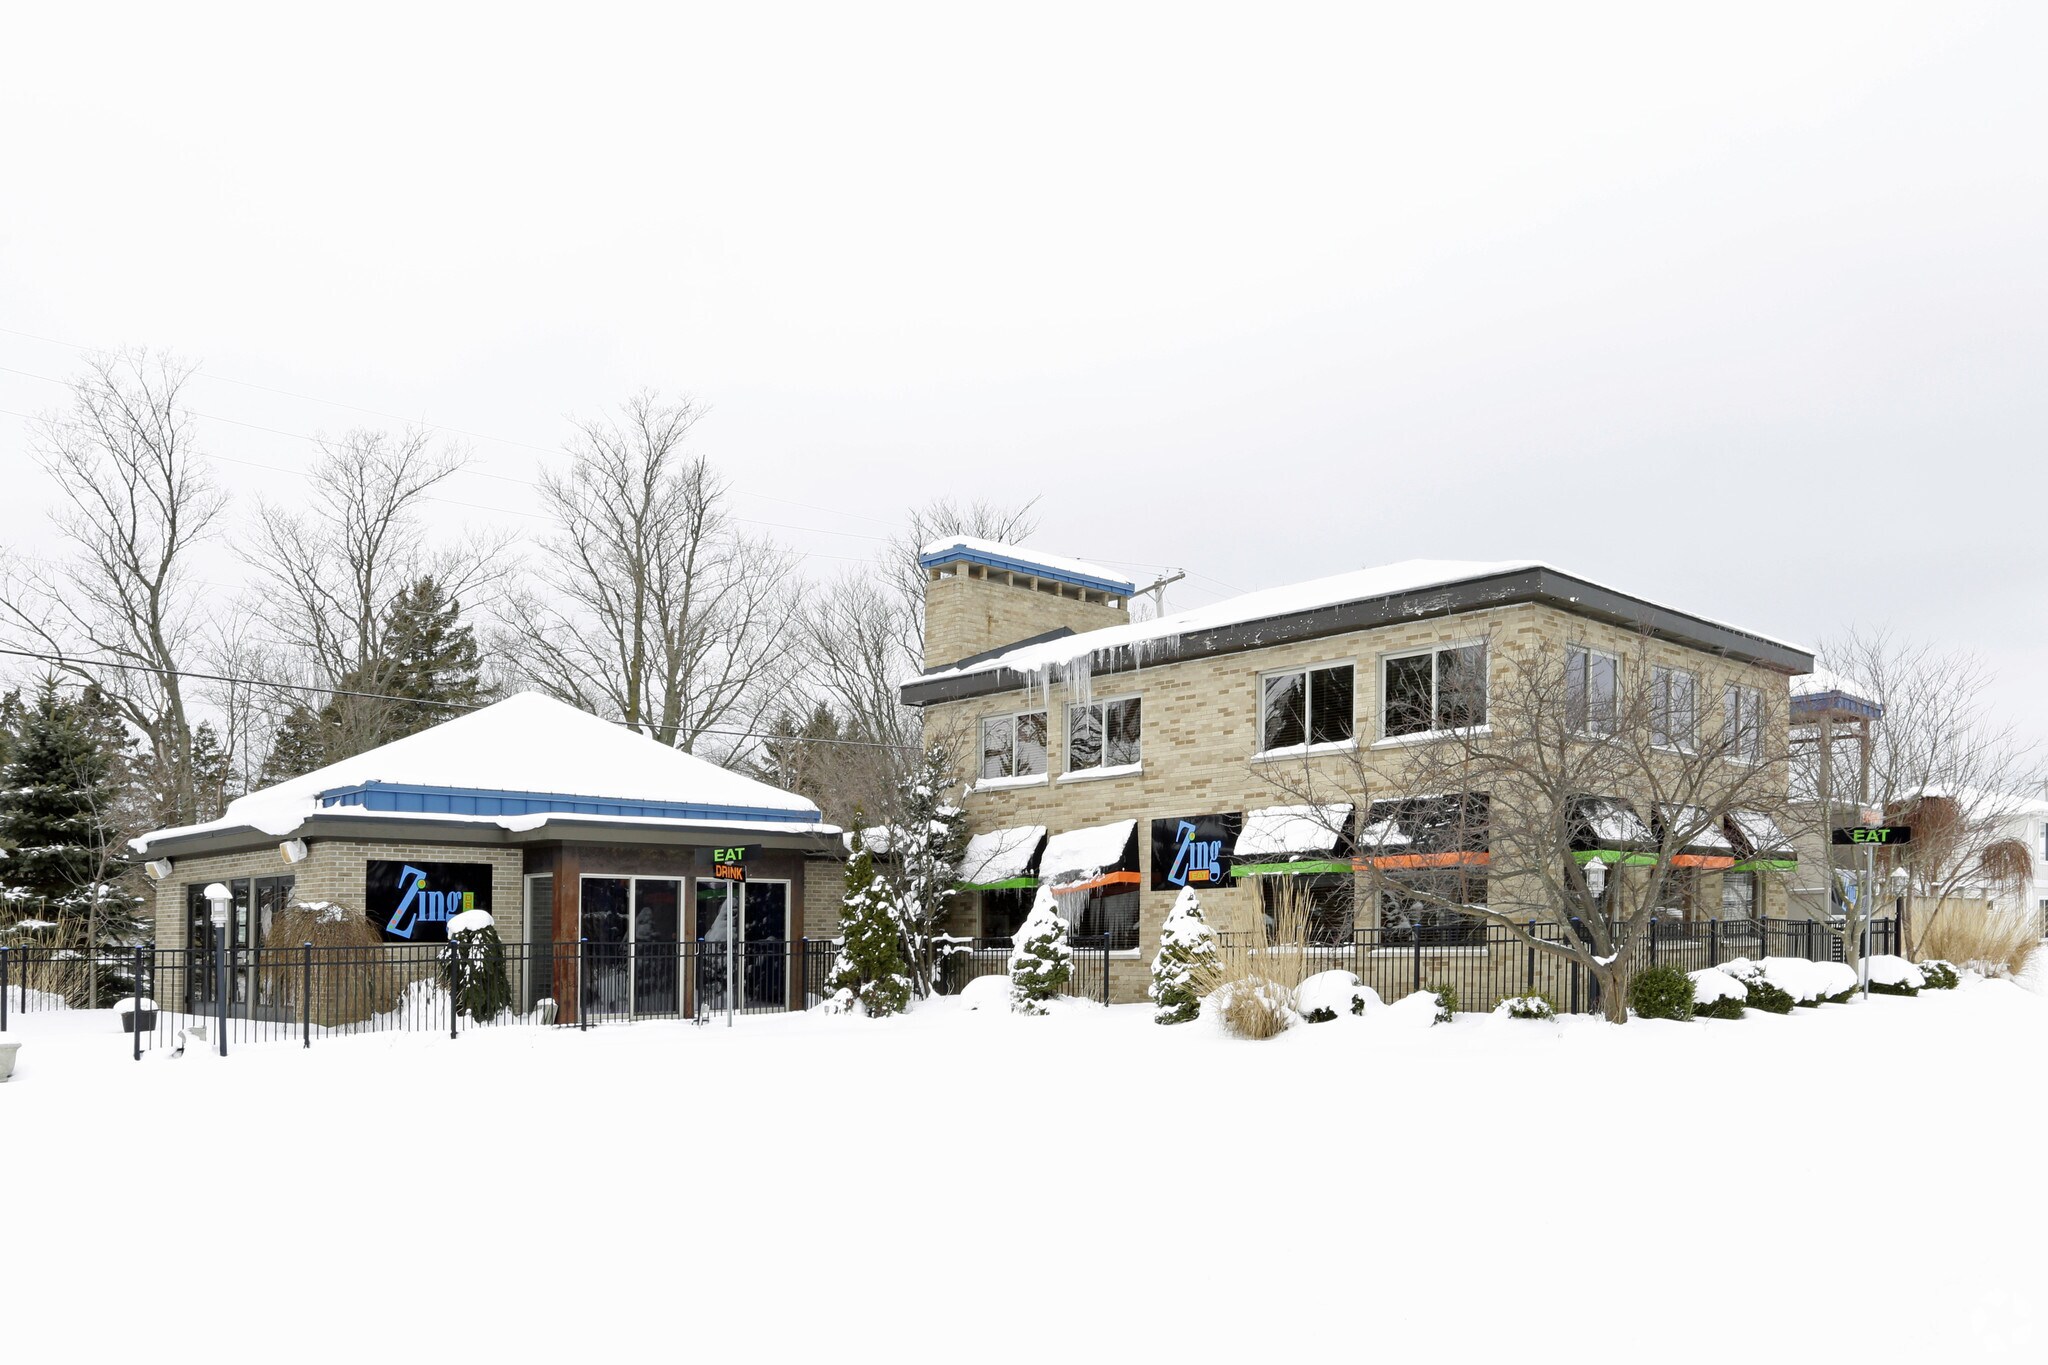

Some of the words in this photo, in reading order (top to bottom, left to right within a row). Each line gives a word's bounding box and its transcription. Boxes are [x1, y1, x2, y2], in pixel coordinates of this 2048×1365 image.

[1853, 829, 1891, 843] EAT
[714, 847, 745, 862] EAT
[1167, 820, 1221, 886] Zing
[715, 864, 743, 880] DRINK
[1191, 871, 1207, 880] EAT
